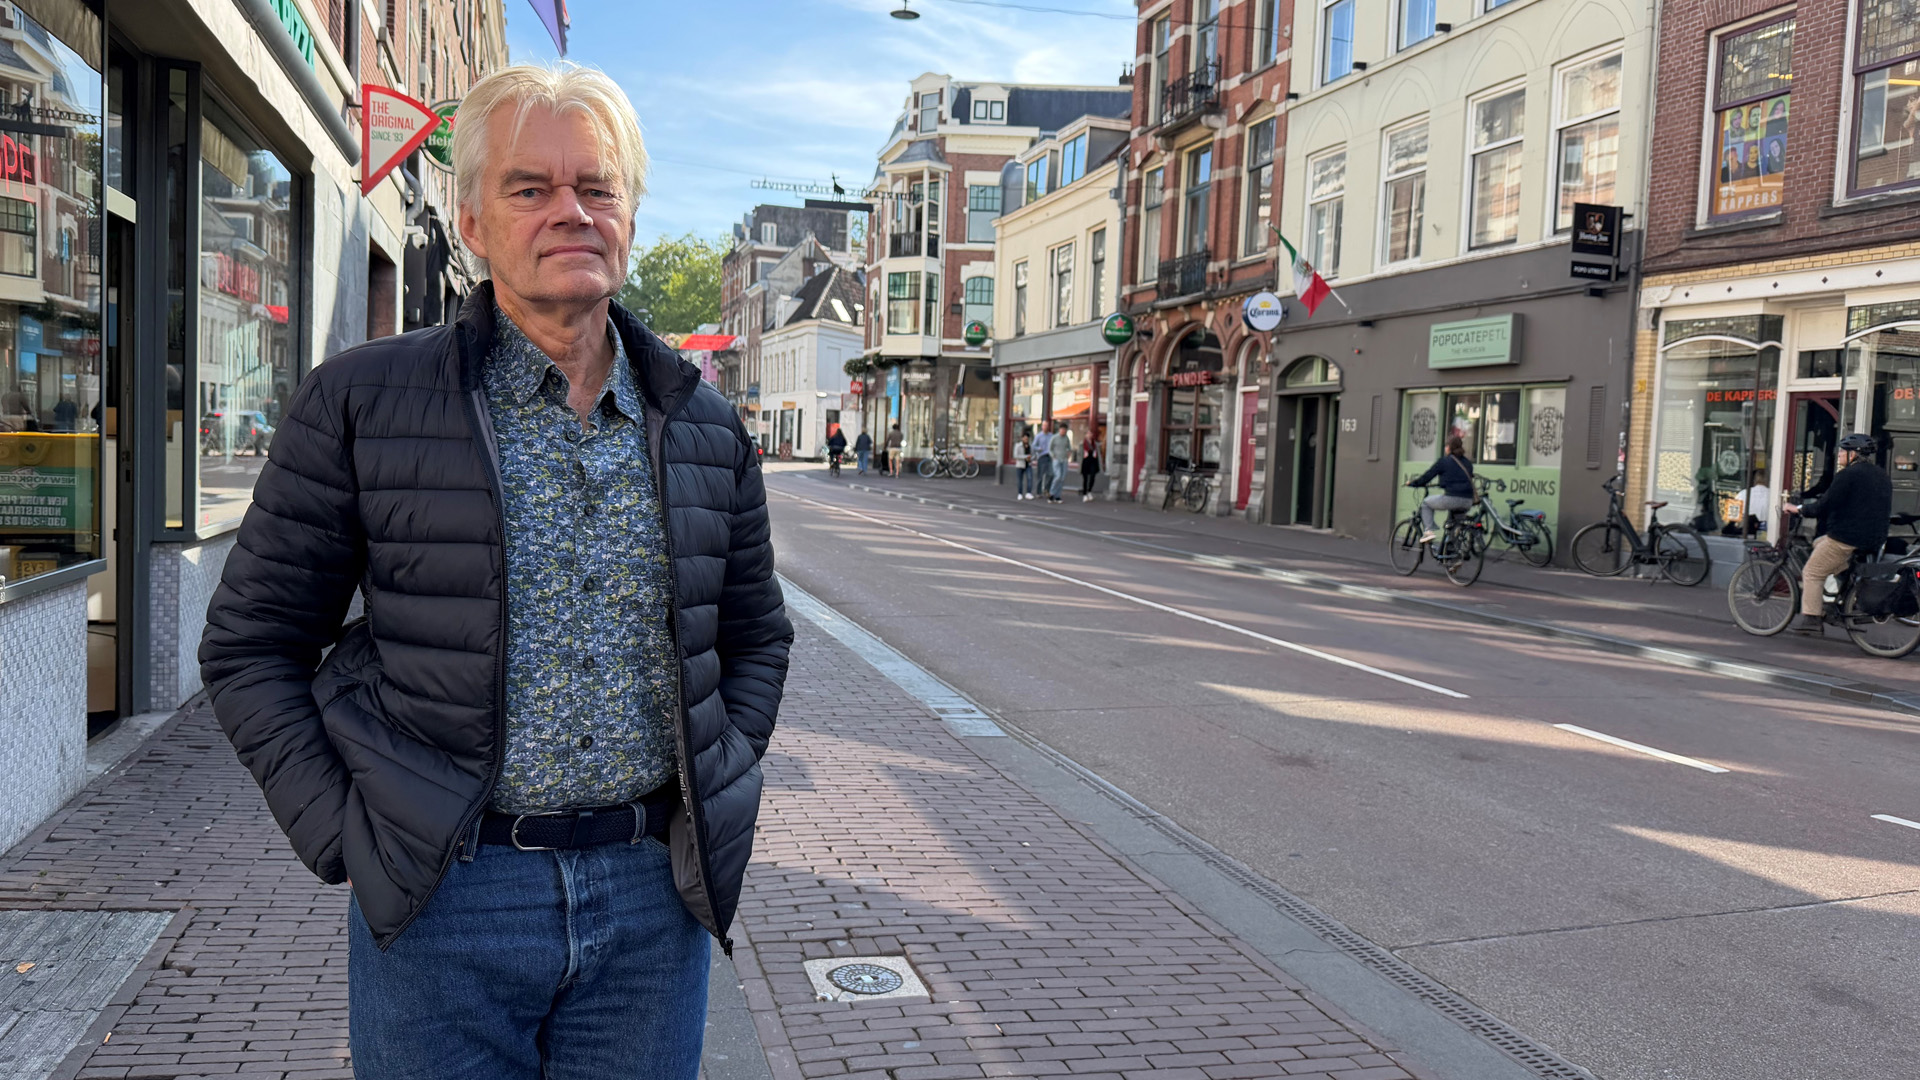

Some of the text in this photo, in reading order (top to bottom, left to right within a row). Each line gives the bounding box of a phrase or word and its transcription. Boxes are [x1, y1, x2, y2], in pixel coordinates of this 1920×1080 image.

[371, 100, 390, 114] THE
[371, 114, 416, 131] ORIGINAL
[371, 130, 391, 141] SINCE
[1720, 190, 1778, 211] KAPPERS
[1432, 328, 1507, 347] POPOCATEPETL
[1706, 391, 1723, 402] DE
[1894, 388, 1914, 400] DE
[1341, 418, 1357, 432] 163
[1510, 478, 1556, 496] DRINKS
